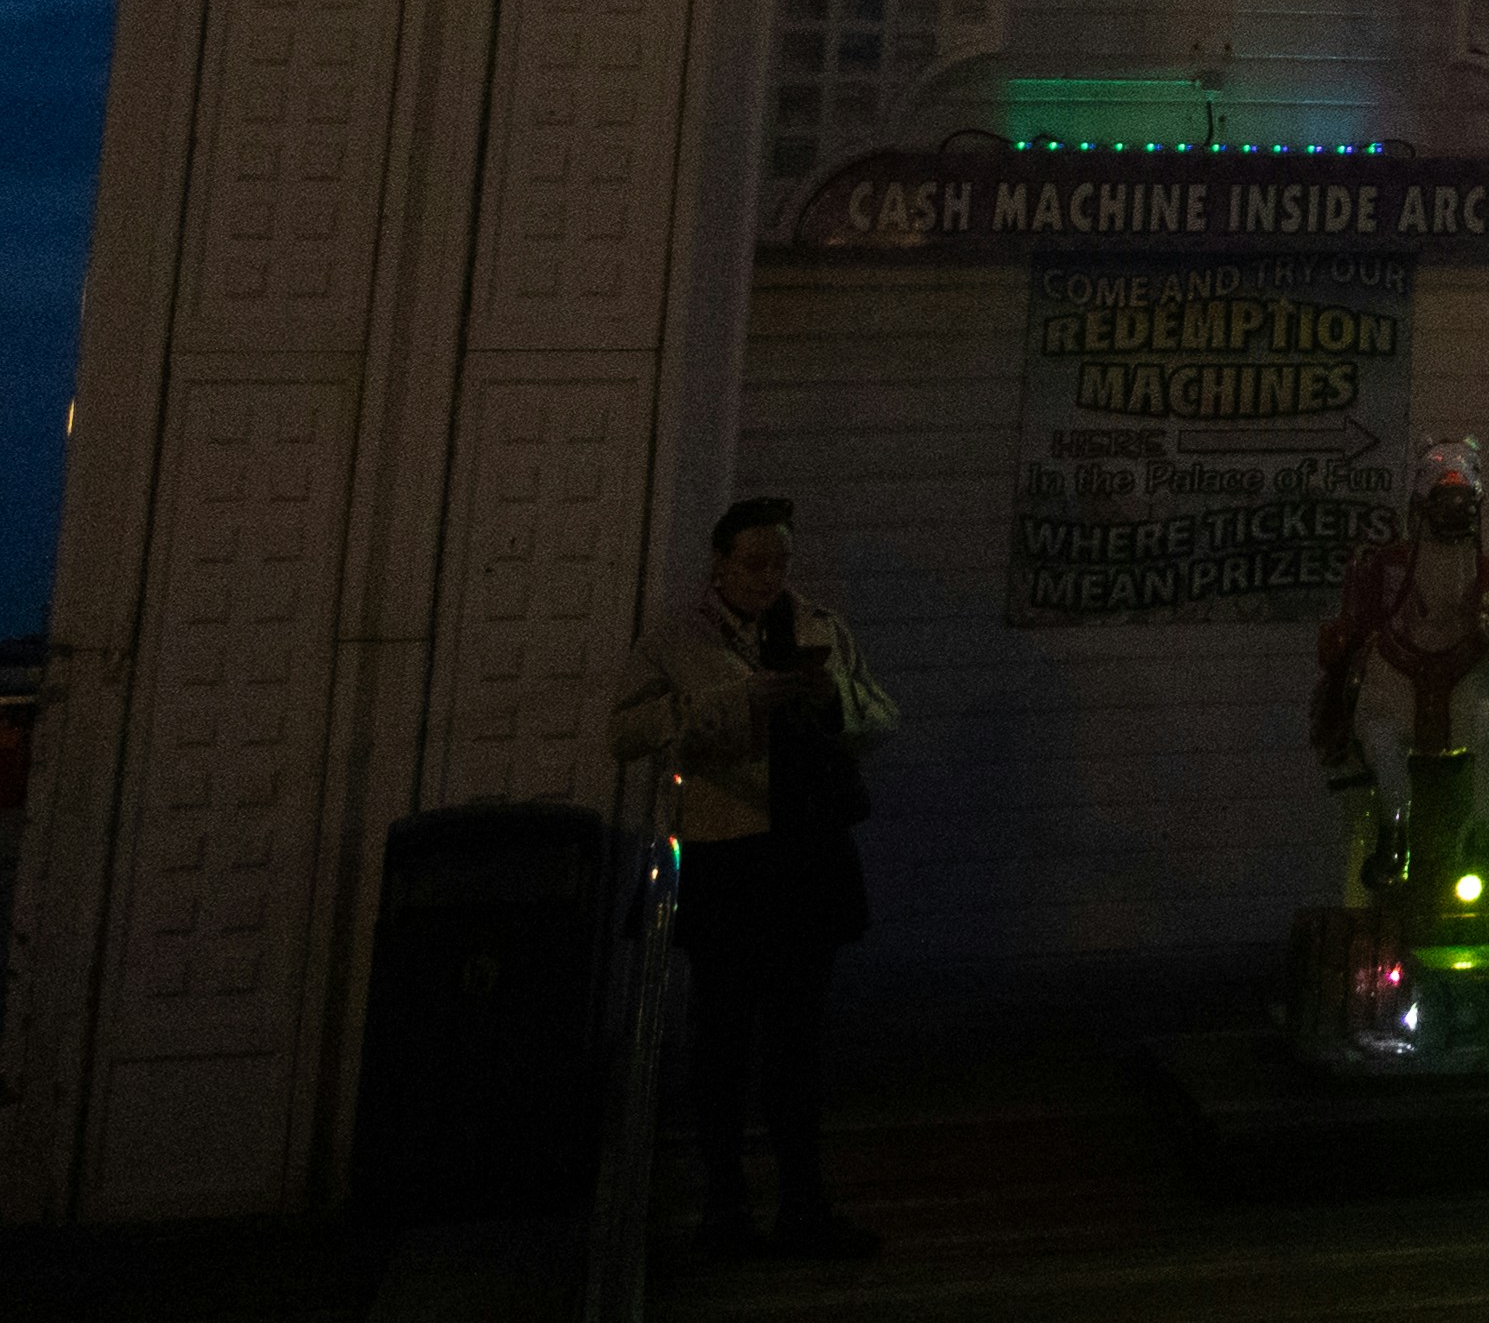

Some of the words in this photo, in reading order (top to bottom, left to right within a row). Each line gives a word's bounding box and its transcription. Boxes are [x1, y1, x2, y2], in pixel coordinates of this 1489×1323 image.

[848, 180, 973, 233] CASH
[990, 183, 1208, 234] MACHINE
[1228, 184, 1380, 234] INSIDE
[1042, 267, 1151, 308] COME
[1159, 264, 1241, 305] AND
[1254, 257, 1318, 289] TRY
[1329, 255, 1407, 295] OUR
[1044, 299, 1397, 354] REDEMPTION
[1078, 362, 1359, 419] MACHINES
[1028, 461, 1066, 498] In
[1075, 460, 1135, 497] the
[1145, 459, 1264, 495] Palace
[1274, 457, 1317, 493] of
[1324, 458, 1393, 493] Fun
[1022, 517, 1195, 561] WHERE
[1204, 500, 1395, 547] TICKETS
[1031, 565, 1179, 611] MEAN
[1188, 545, 1347, 599] PRIZES
